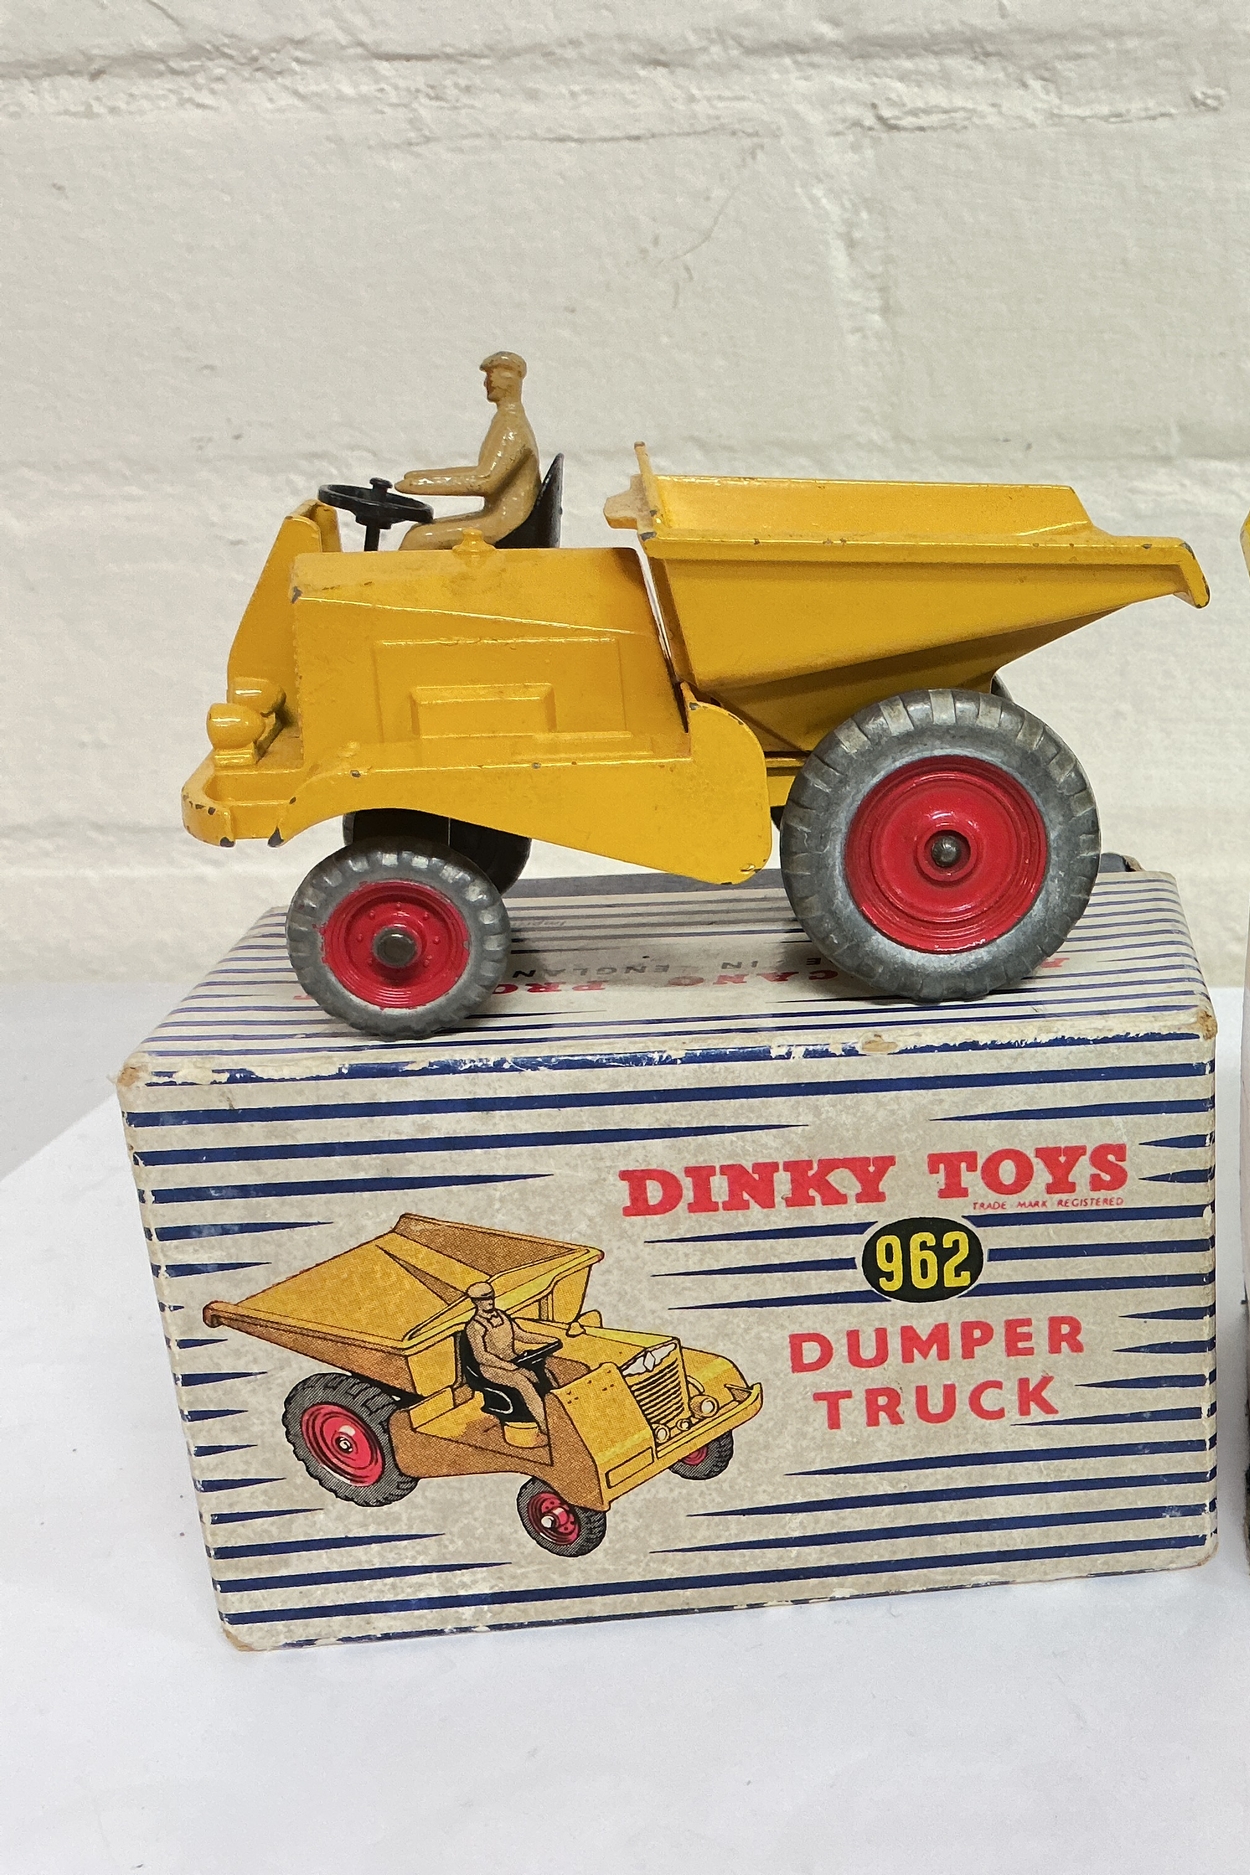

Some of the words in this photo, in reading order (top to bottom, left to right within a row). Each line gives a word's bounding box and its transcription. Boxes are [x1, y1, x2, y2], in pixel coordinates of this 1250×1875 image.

[511, 963, 670, 978] ENGLAN
[720, 960, 759, 970] IN
[618, 1155, 897, 1217] DINKY
[926, 1143, 1129, 1200] TOYS
[972, 1201, 1007, 1211] TRADE
[1016, 1200, 1048, 1209] MARK
[1057, 1197, 1124, 1208] REGISTERED
[875, 1230, 972, 1291] 962
[788, 1314, 1085, 1374] DUMPER
[812, 1373, 1060, 1431] TRUCK
